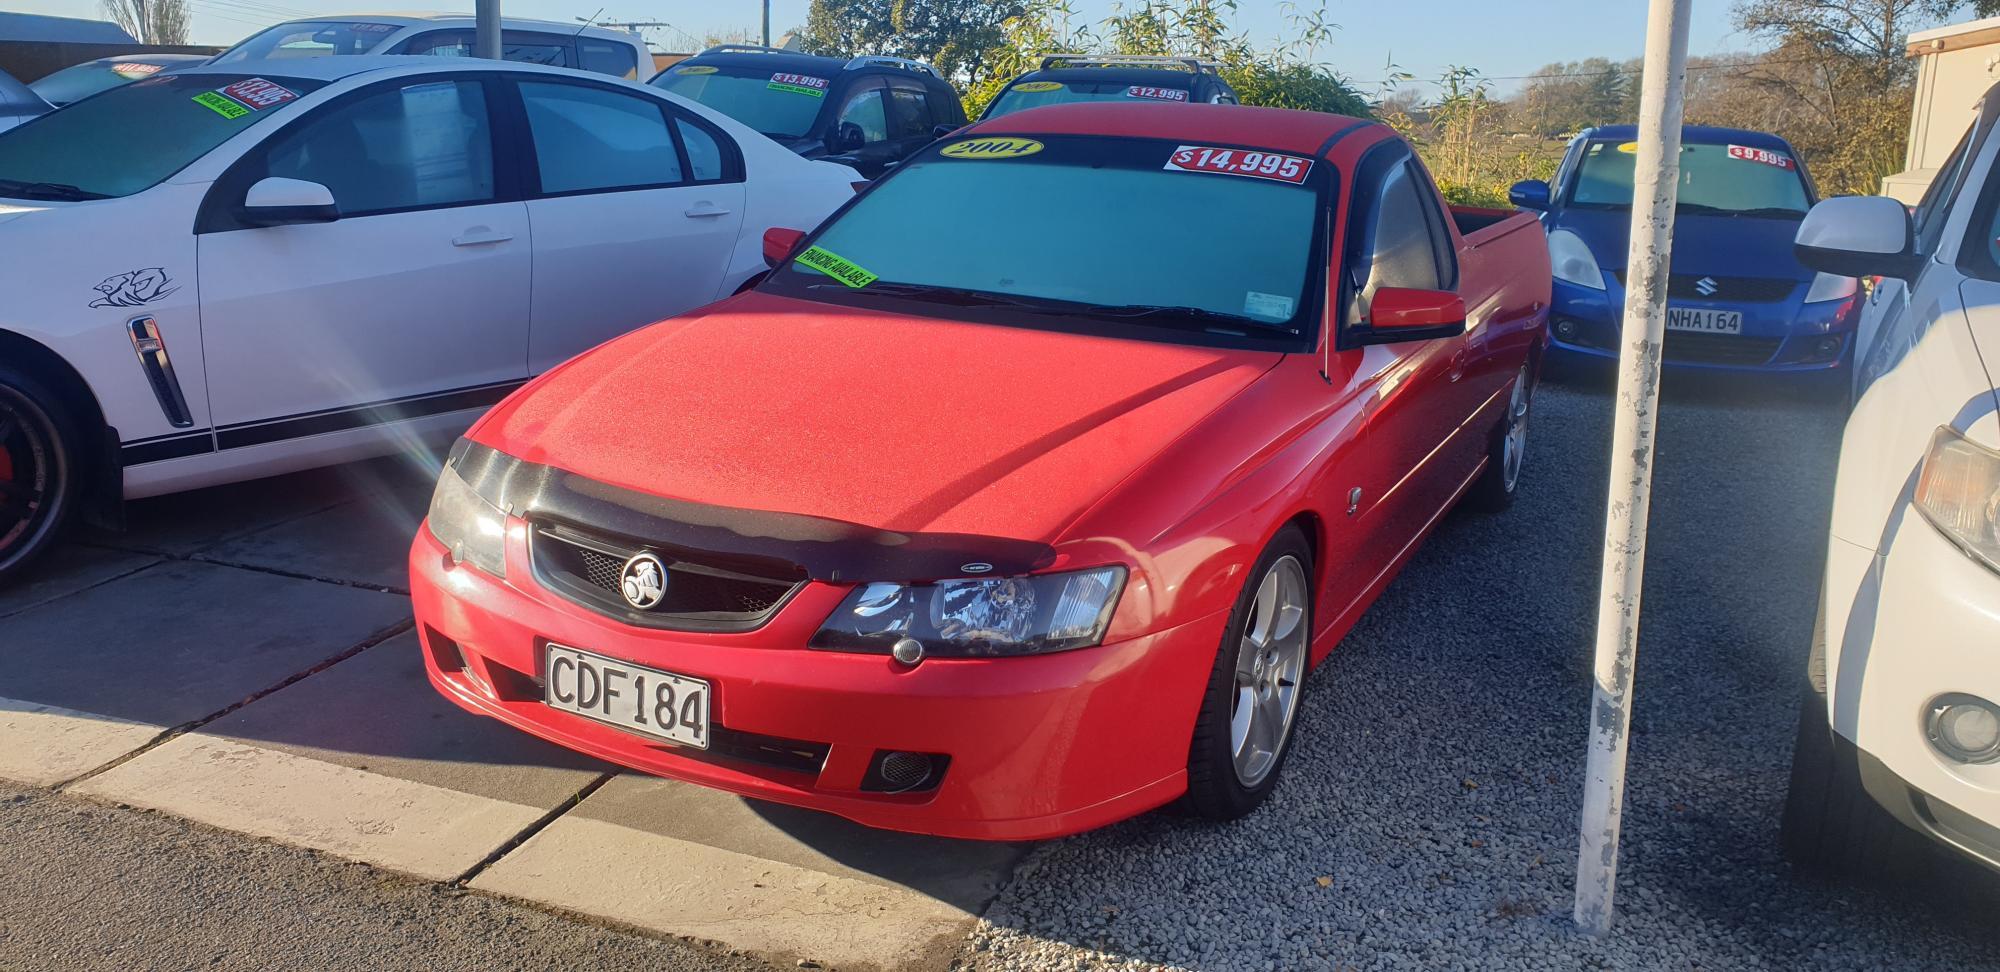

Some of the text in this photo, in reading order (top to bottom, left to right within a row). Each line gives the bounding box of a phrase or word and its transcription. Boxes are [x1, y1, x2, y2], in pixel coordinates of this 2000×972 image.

[774, 74, 825, 88] $13,995
[1130, 86, 1184, 101] $12,995
[947, 141, 1037, 154] 2004
[1734, 147, 1788, 168] $9,995
[1176, 149, 1303, 178] $14,995
[802, 248, 873, 287] FINANCING AVAILABLE
[1667, 309, 1739, 331] NHA164
[551, 655, 702, 739] CDF184
